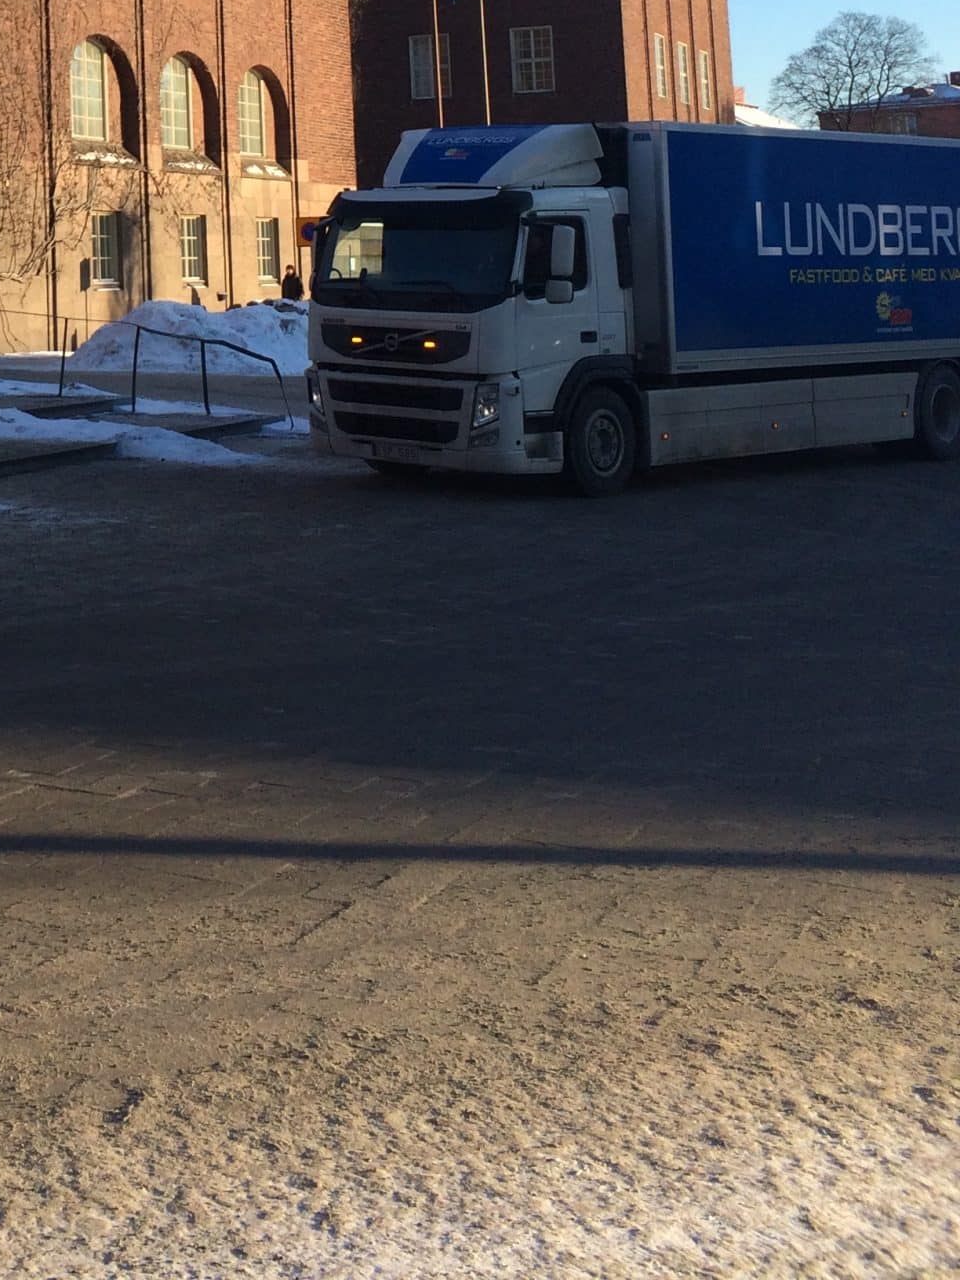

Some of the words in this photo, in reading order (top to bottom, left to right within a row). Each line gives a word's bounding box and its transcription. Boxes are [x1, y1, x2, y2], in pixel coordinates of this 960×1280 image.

[755, 201, 960, 256] LUNDBER
[790, 268, 859, 284] FASTFOOD
[862, 266, 873, 282] &
[875, 264, 907, 283] CAFÉ
[911, 268, 936, 282] MED
